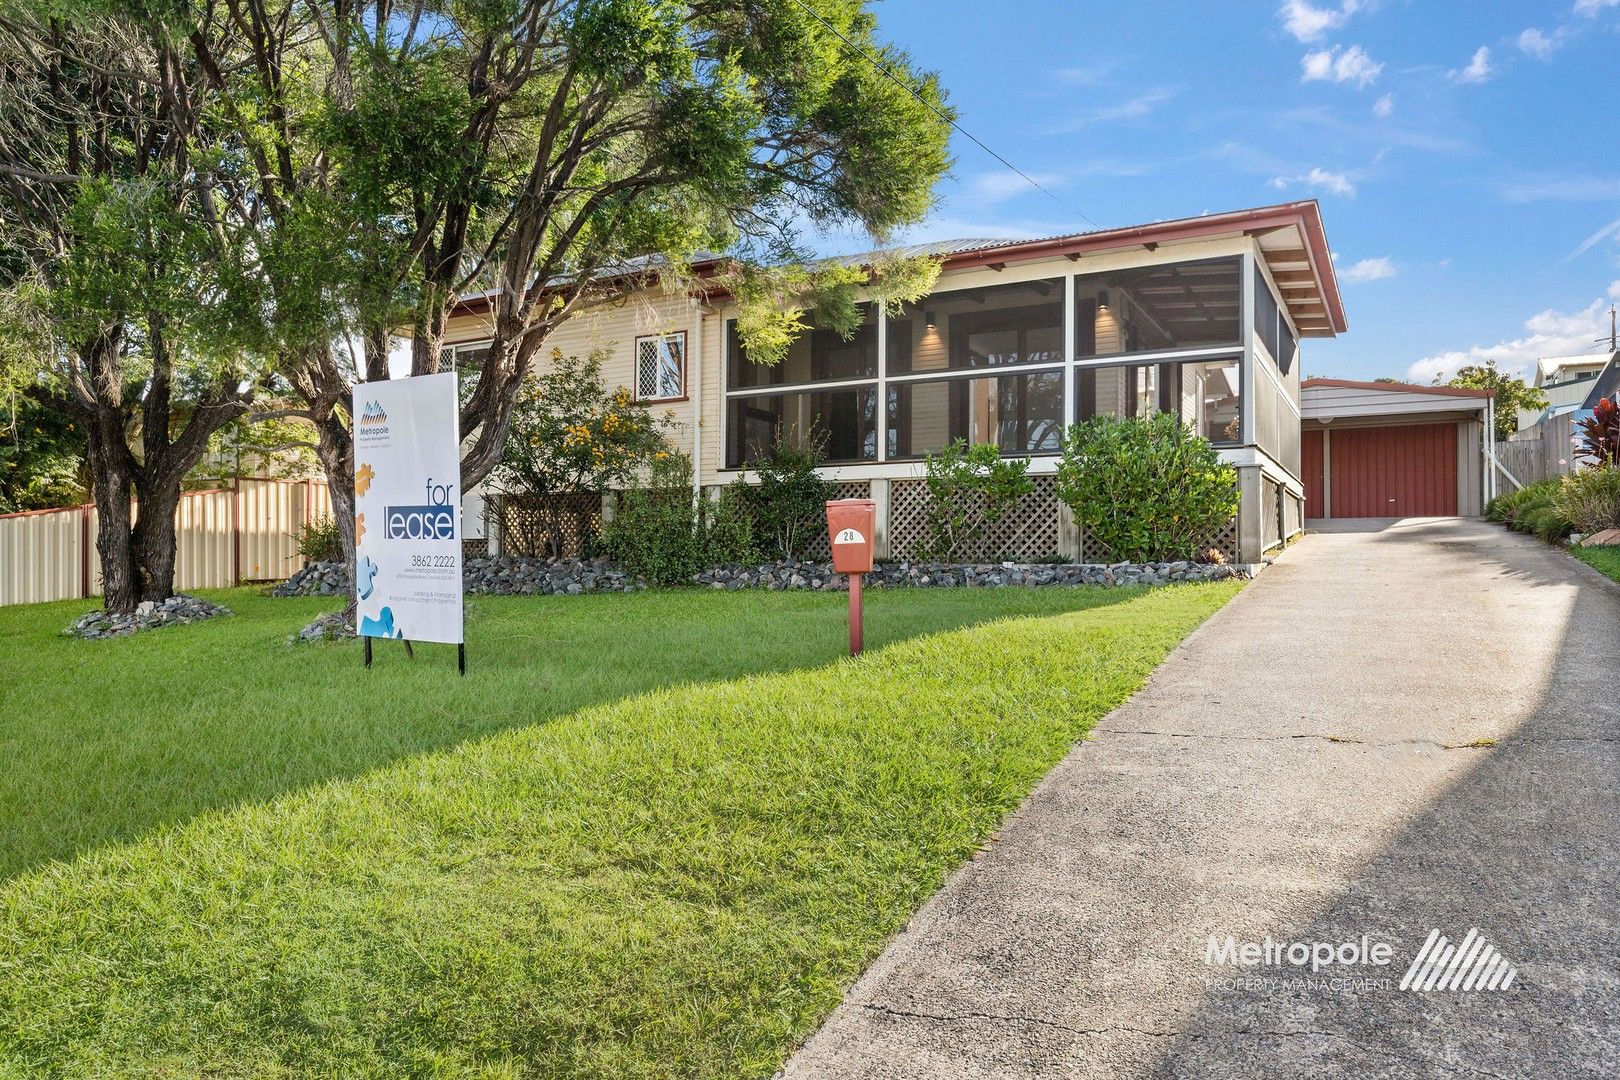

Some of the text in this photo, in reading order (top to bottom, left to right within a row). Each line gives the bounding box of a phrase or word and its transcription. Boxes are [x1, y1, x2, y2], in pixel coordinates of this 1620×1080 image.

[426, 478, 453, 506] for
[385, 506, 453, 540] lease
[843, 531, 854, 541] 28
[411, 555, 455, 568] 3862 2222
